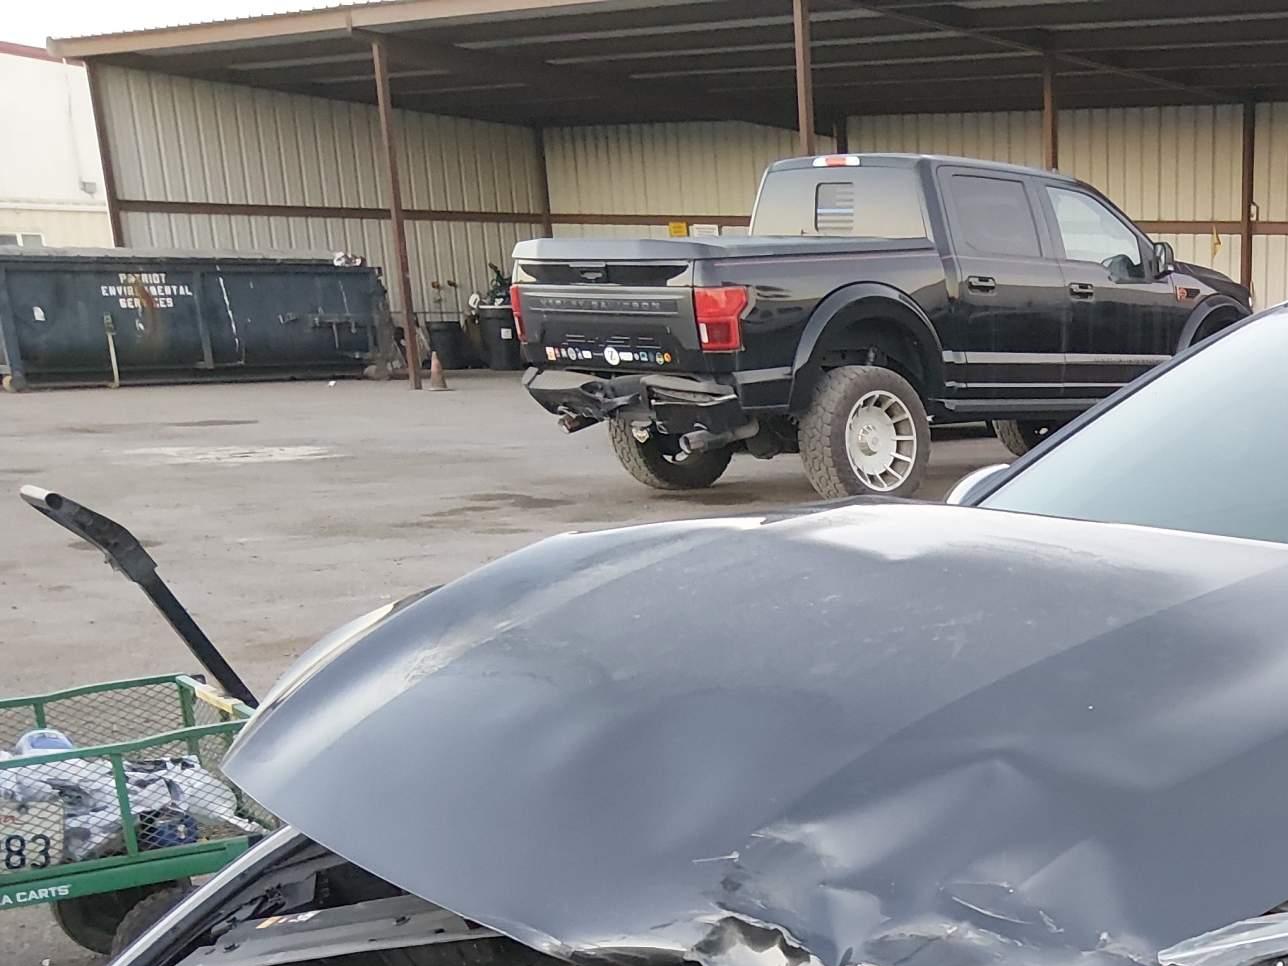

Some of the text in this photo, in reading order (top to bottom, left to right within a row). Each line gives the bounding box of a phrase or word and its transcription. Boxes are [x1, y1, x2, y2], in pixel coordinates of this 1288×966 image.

[118, 273, 167, 284] PATRIOT
[100, 285, 193, 296] ENVIRMENTAL
[118, 298, 173, 308] SERCES
[16, 884, 72, 902] CARTS
